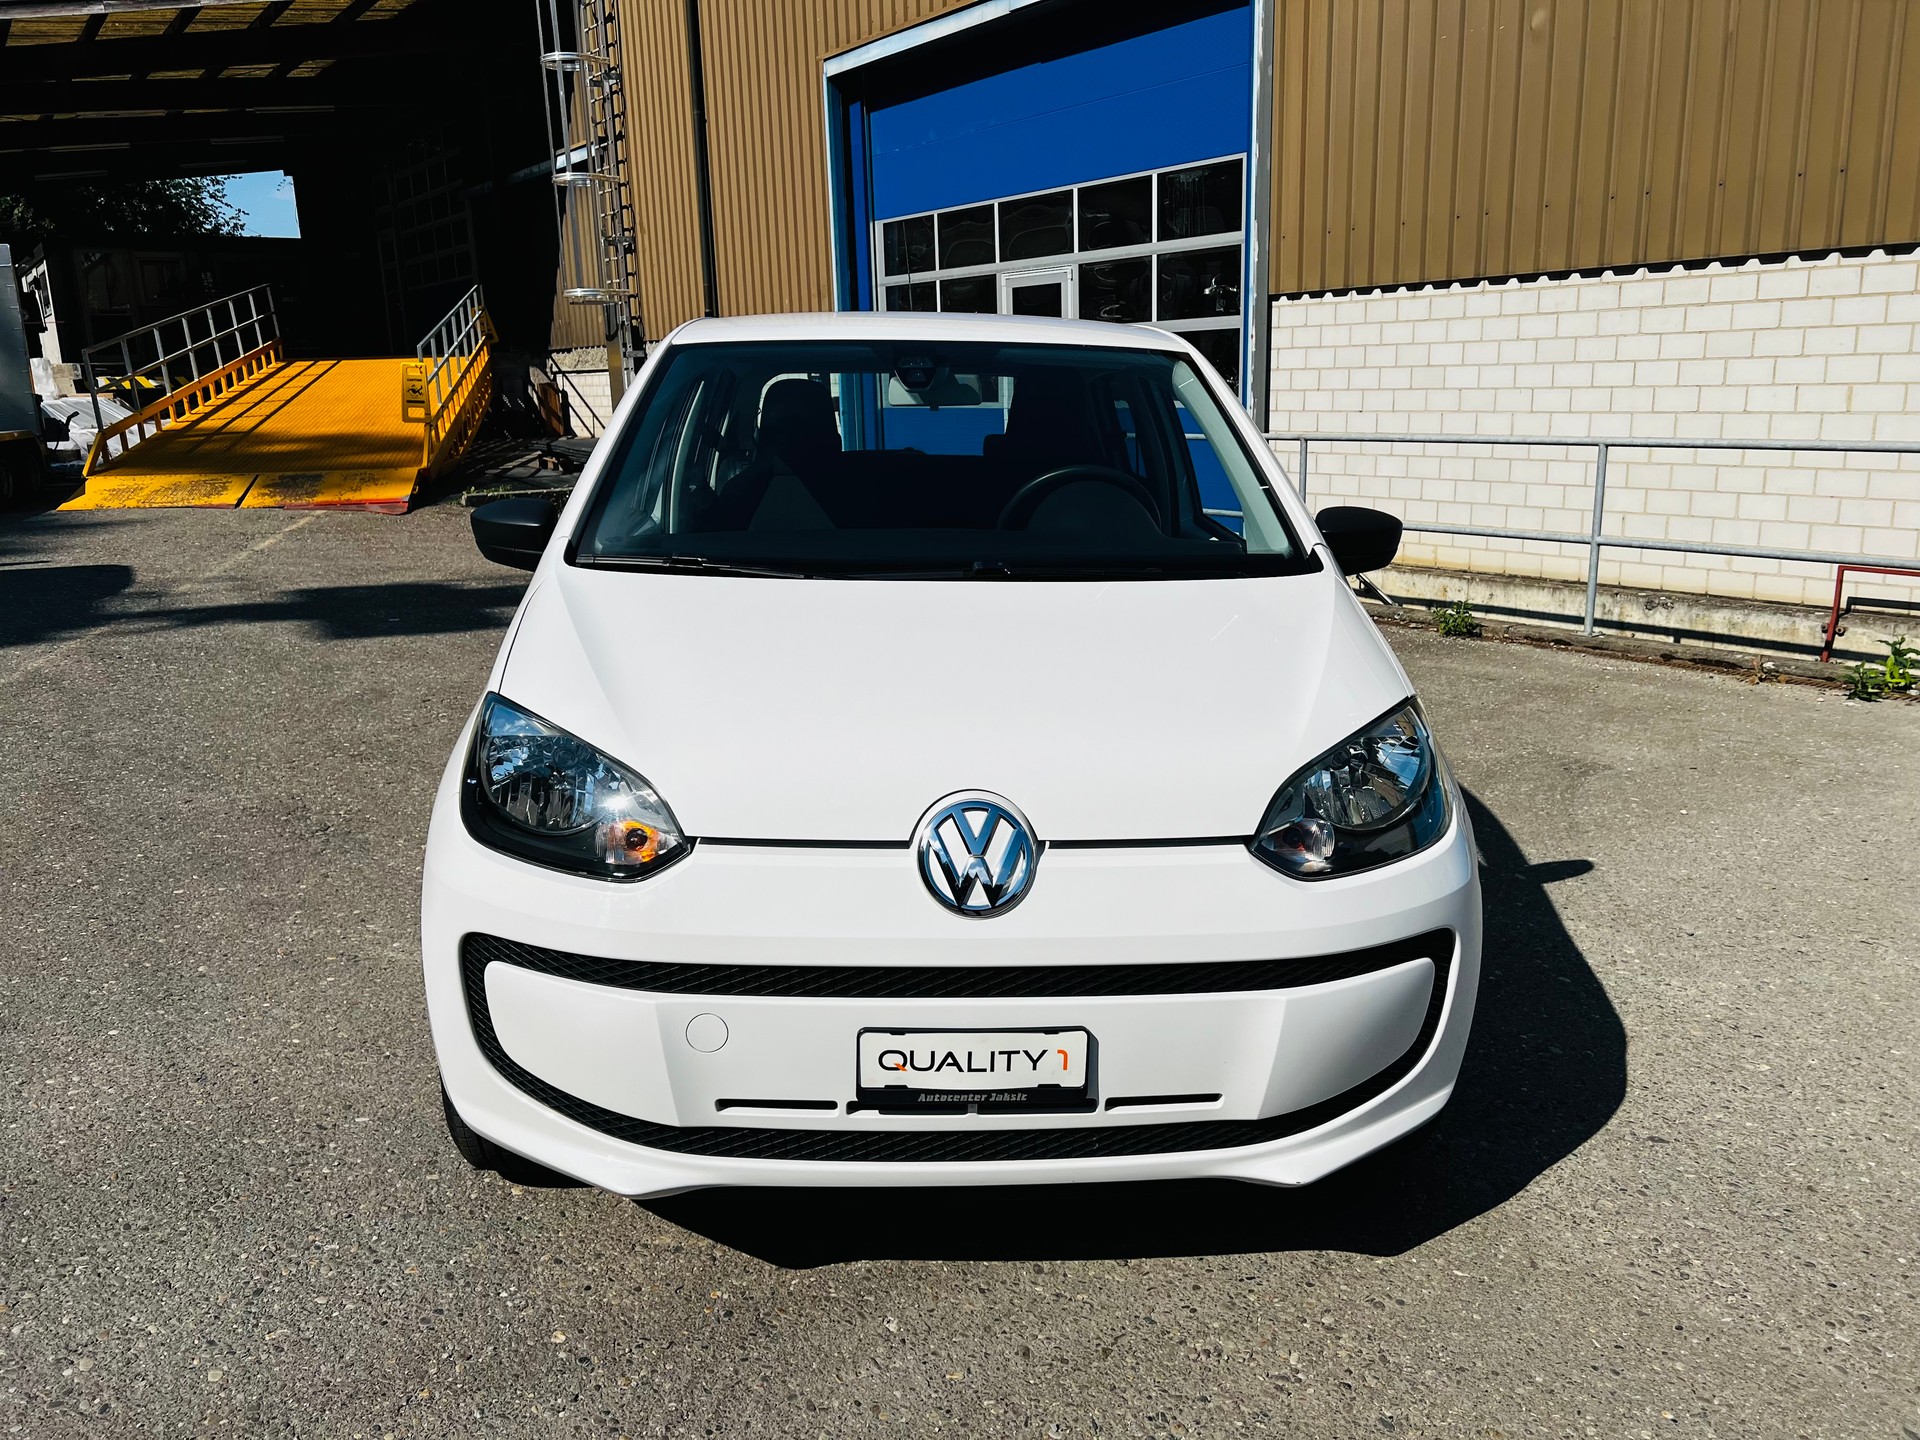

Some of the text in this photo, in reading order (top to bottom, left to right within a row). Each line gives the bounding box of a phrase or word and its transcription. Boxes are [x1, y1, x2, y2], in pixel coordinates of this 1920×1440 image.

[919, 798, 1036, 917] VW
[878, 1049, 1068, 1073] QUALITY 1
[918, 1093, 987, 1102] Autocenter
